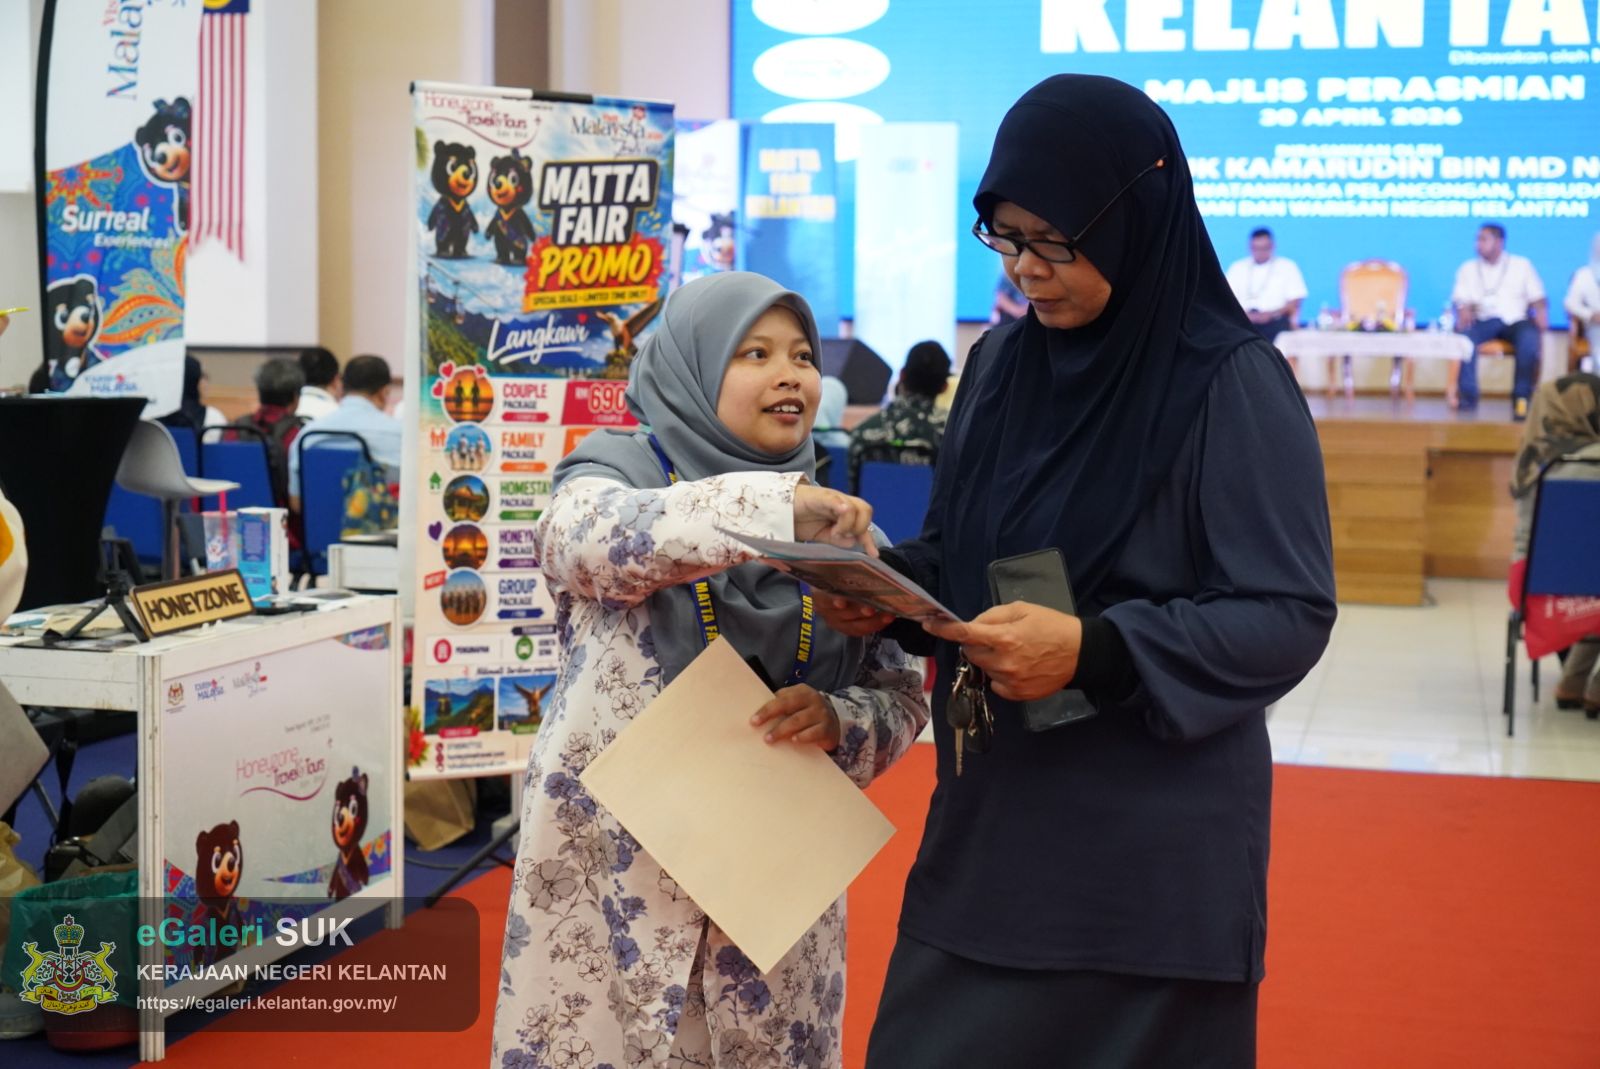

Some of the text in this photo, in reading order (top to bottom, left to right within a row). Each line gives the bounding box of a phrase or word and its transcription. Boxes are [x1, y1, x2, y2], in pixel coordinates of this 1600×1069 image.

[1040, 0, 1600, 53] KELANTA
[106, 0, 143, 100] Mala
[1145, 75, 1585, 104] MAJLIS PERASMIAN
[1301, 107, 1386, 127] APRIL
[1391, 106, 1462, 126] 2026
[1224, 156, 1434, 179] KAMARUDIN
[1440, 156, 1501, 179] BIN
[1506, 156, 1567, 179] MD
[542, 164, 650, 205] MATTA
[61, 204, 150, 233] Surreal
[1470, 200, 1589, 217] KELANTAN
[557, 205, 629, 245] FAIR
[539, 245, 652, 289] PROMO
[486, 313, 588, 361] Langkawi
[503, 383, 548, 399] COUPLE
[503, 400, 537, 410] PACKAGE
[588, 382, 628, 414] 690
[502, 432, 545, 448] FAMILY
[501, 450, 535, 460] PACKAGE
[500, 498, 534, 508] PACKAGE
[500, 546, 533, 556] PACKAGE
[499, 579, 537, 595] GROUP
[144, 582, 245, 623] HONEYZONE
[498, 597, 533, 607] PACKAGE
[695, 581, 715, 623] MATTA
[797, 594, 814, 662] MATTA FAIR
